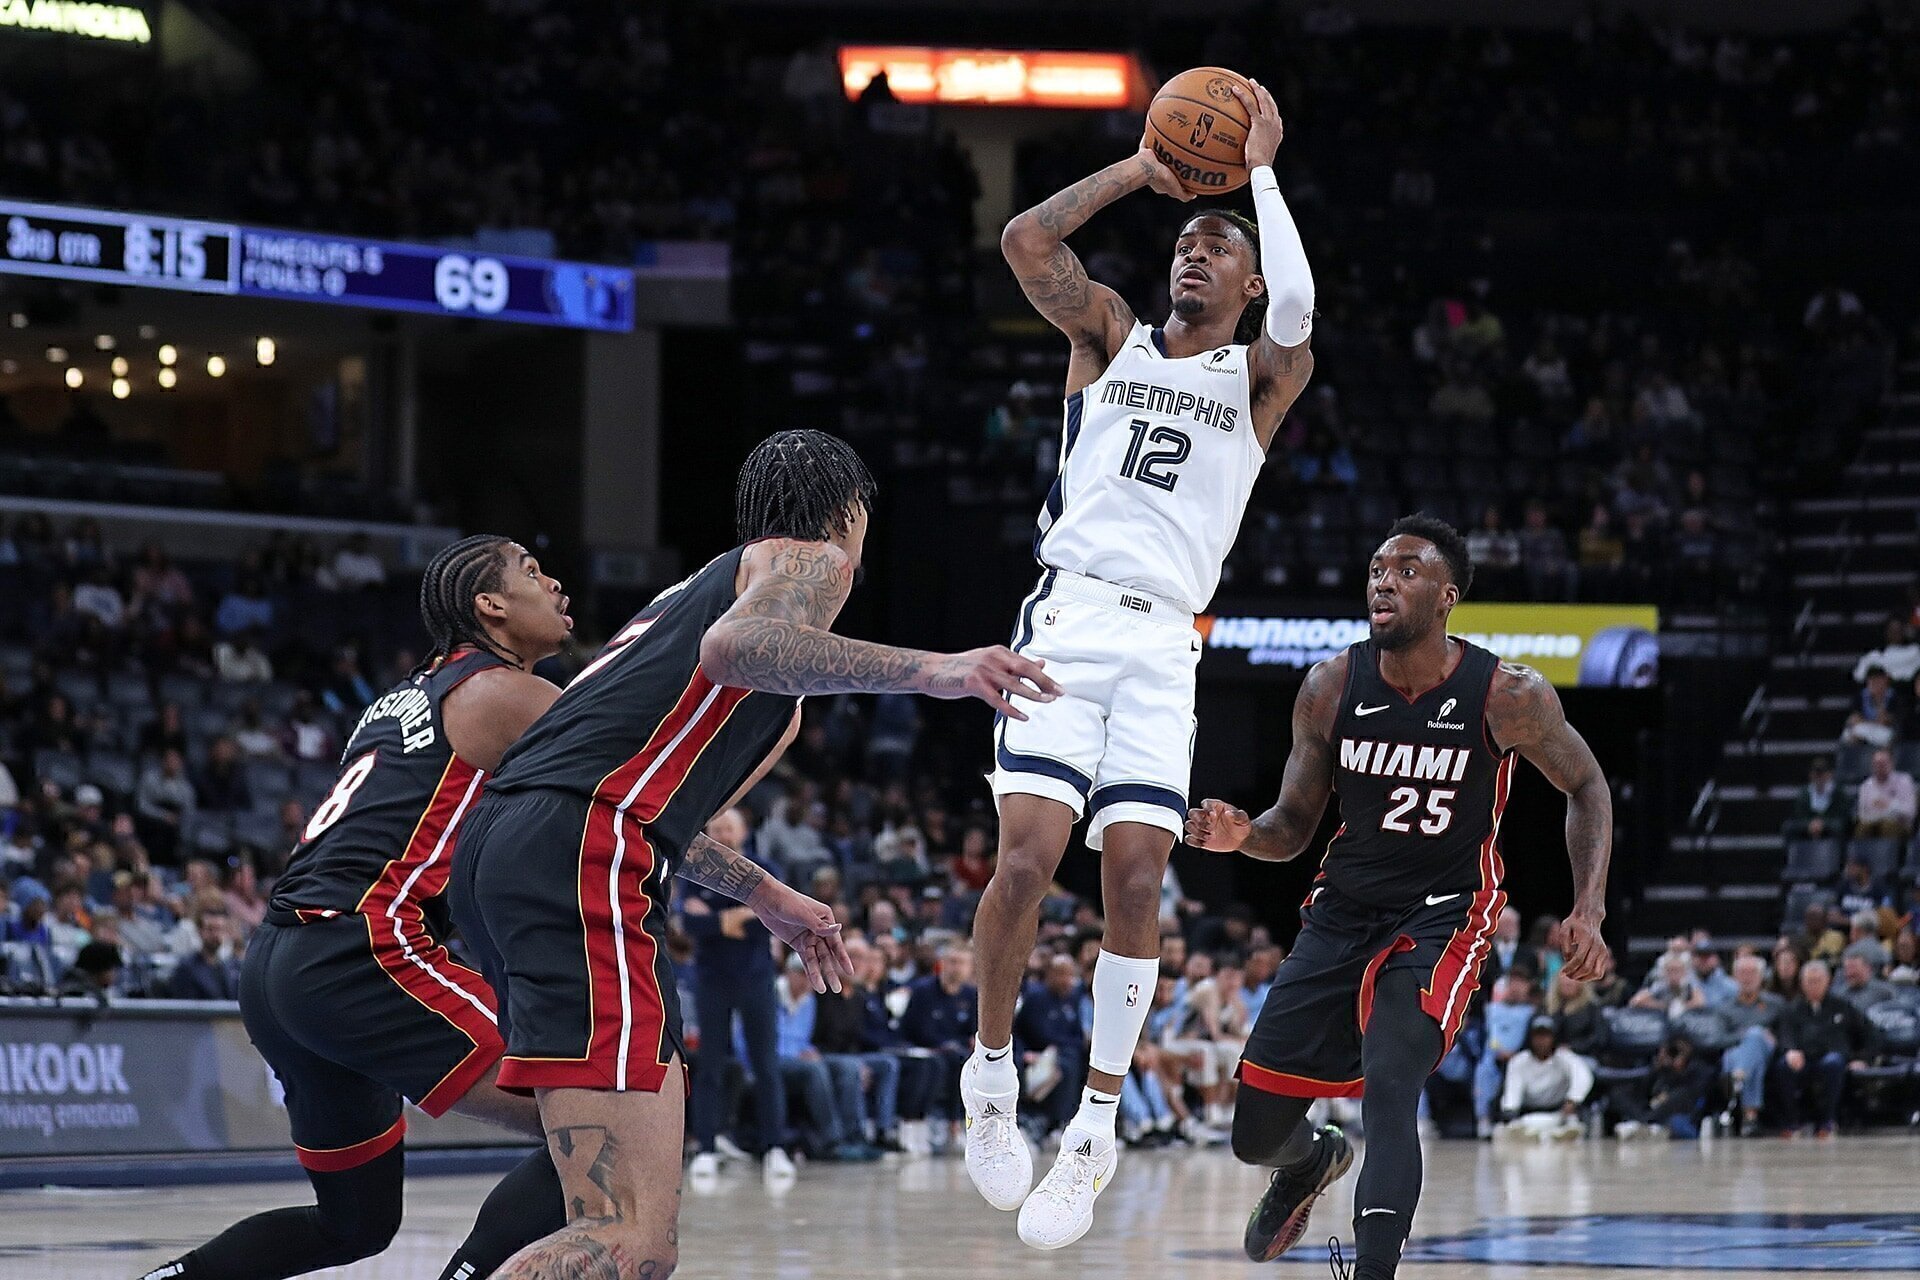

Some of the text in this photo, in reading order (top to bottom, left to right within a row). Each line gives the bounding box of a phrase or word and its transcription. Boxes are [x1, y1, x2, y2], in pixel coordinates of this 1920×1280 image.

[1153, 136, 1228, 186] Wilson
[435, 254, 509, 313] 69
[1100, 380, 1239, 433] MEMPHIS
[1119, 418, 1192, 493] 12
[1427, 720, 1465, 731] Robinhood
[1339, 738, 1471, 782] MIAMI
[301, 750, 377, 842] 8
[1381, 785, 1457, 835] 25
